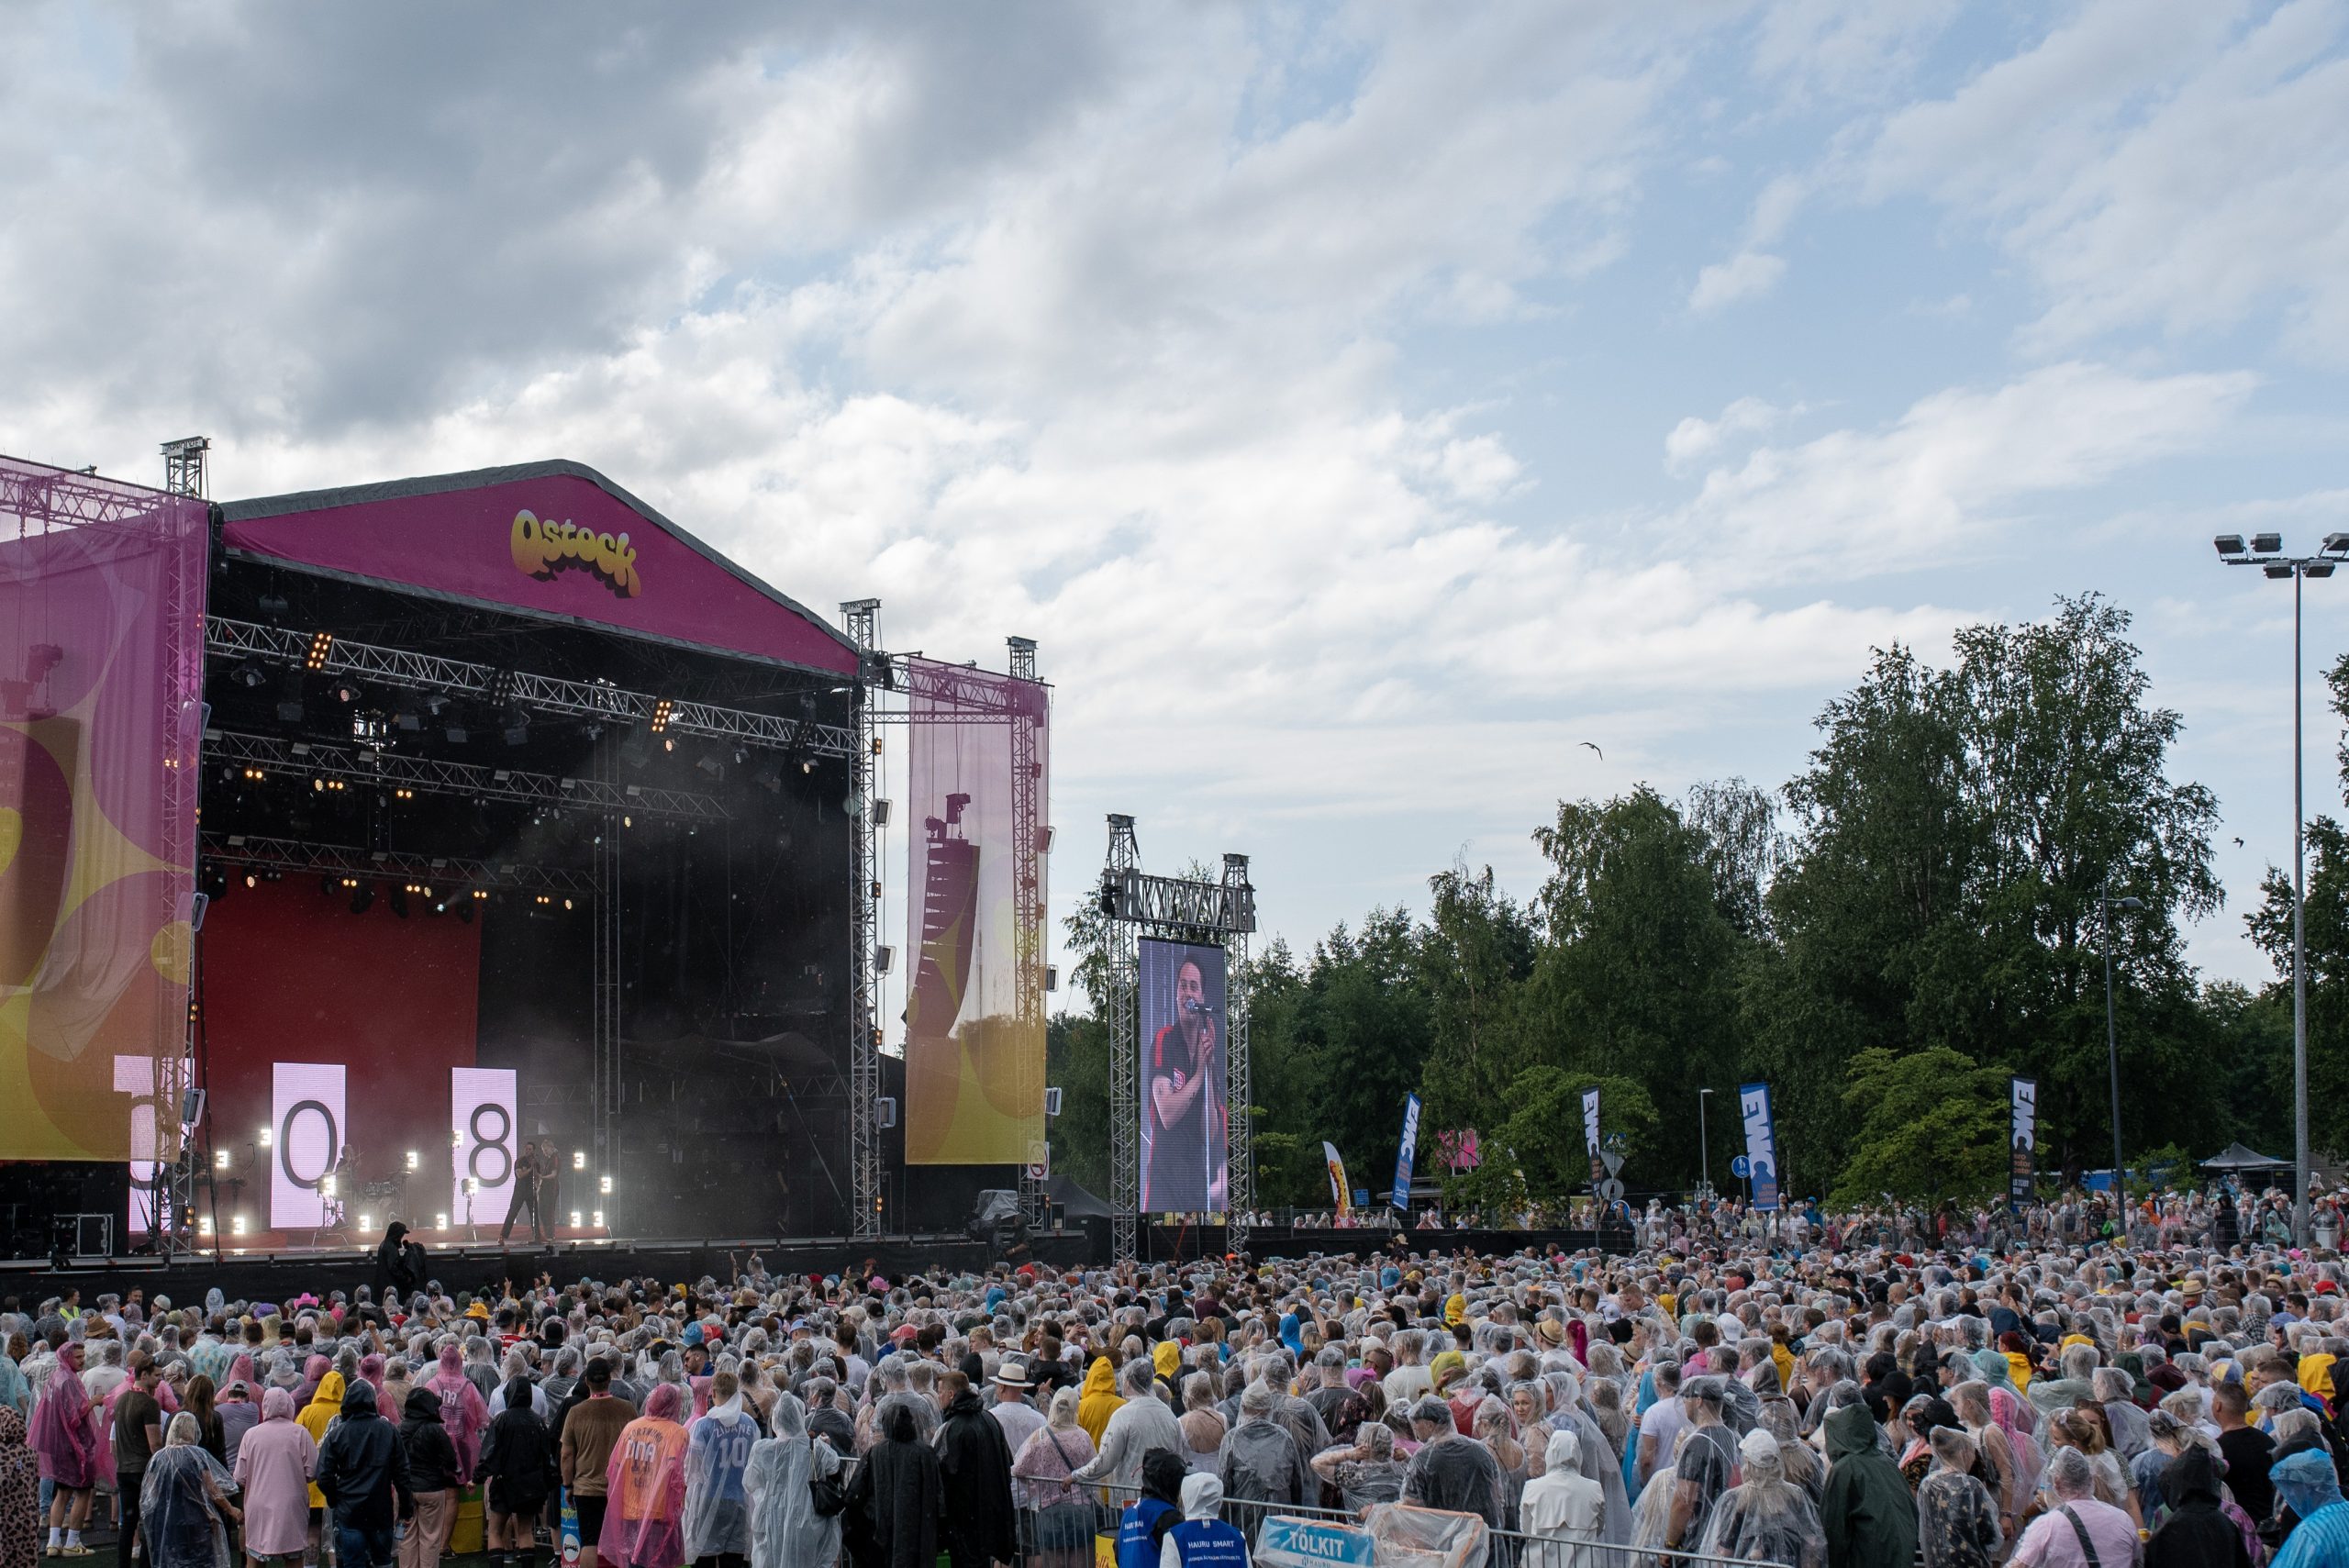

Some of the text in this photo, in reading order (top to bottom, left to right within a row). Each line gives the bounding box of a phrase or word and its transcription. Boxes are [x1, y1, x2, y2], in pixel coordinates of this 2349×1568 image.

[510, 508, 641, 598] Qstock
[468, 1103, 512, 1188] 8
[713, 1423, 752, 1438] ZIDANE
[718, 1437, 747, 1469] 10
[1187, 1540, 1235, 1550] HAURU SMART
[1289, 1528, 1344, 1559] TÖLKIT
